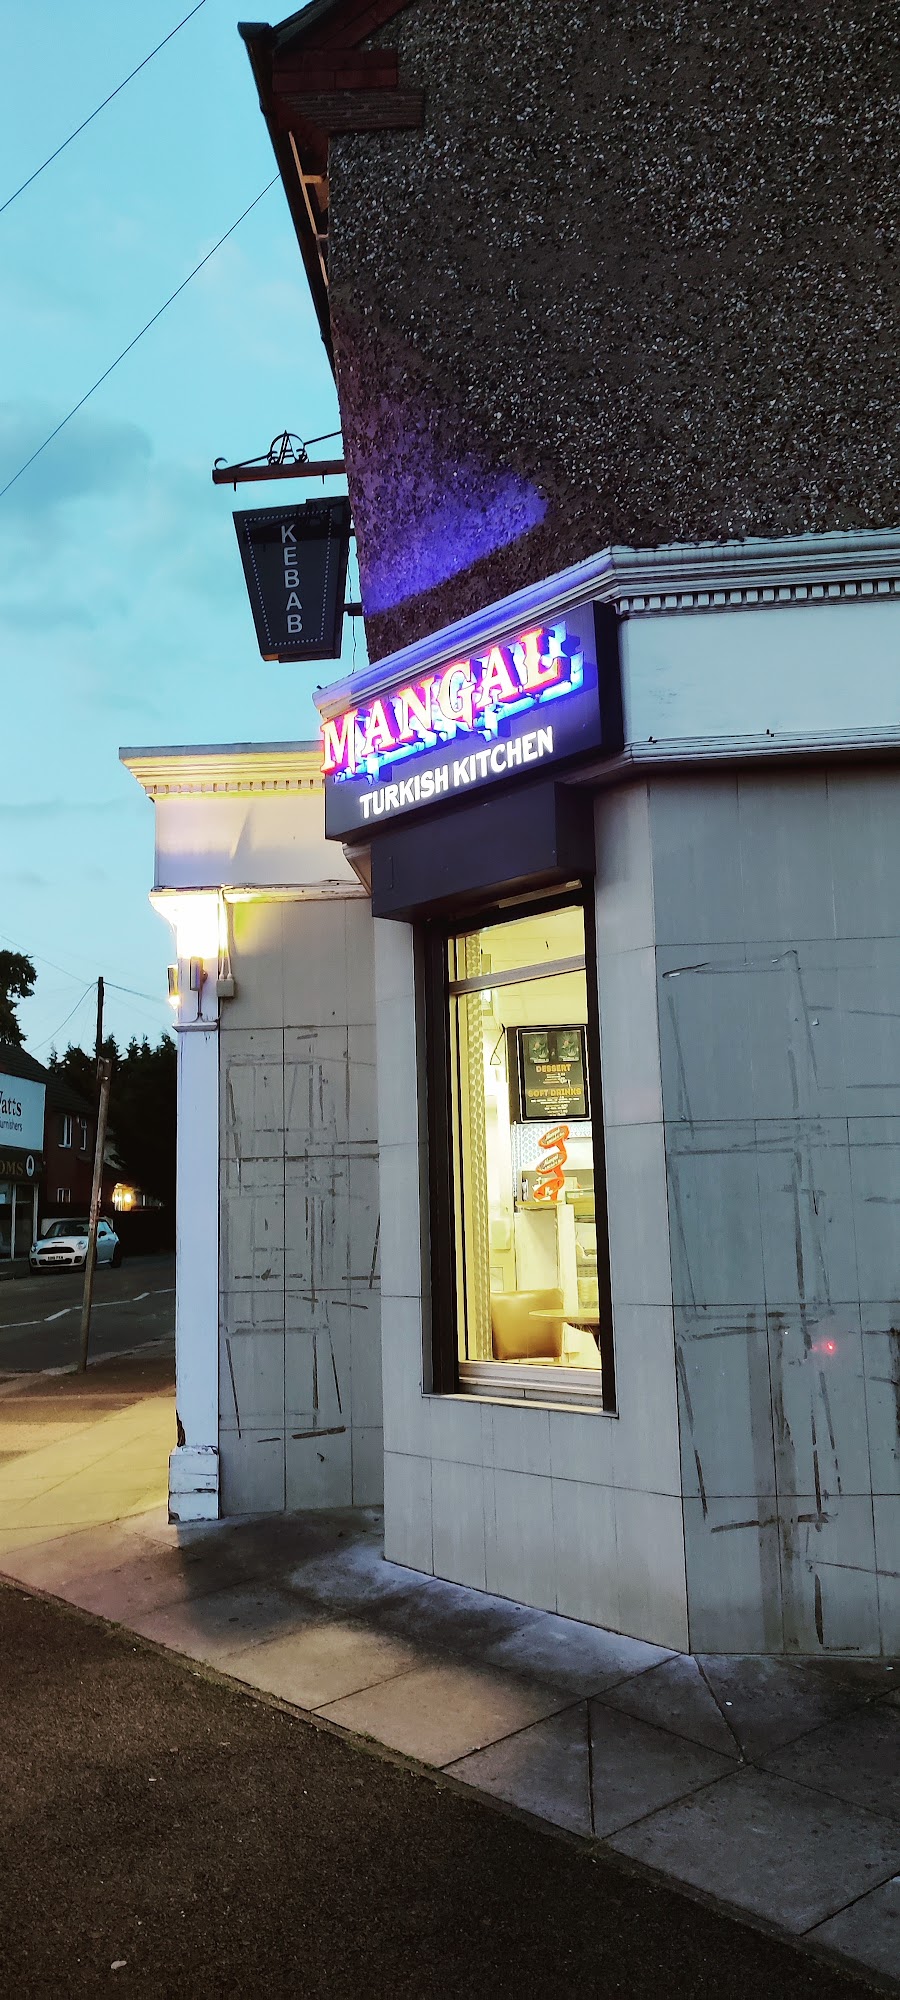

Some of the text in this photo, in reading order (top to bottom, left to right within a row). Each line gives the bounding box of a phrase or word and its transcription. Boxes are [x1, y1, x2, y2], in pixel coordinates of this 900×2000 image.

[281, 524, 303, 634] KEBAB
[320, 626, 564, 776] MANGAL
[359, 725, 554, 820] TURKISH KITCHEN
[535, 1063, 572, 1073] DESSERT
[550, 1086, 582, 1097] DRINKS
